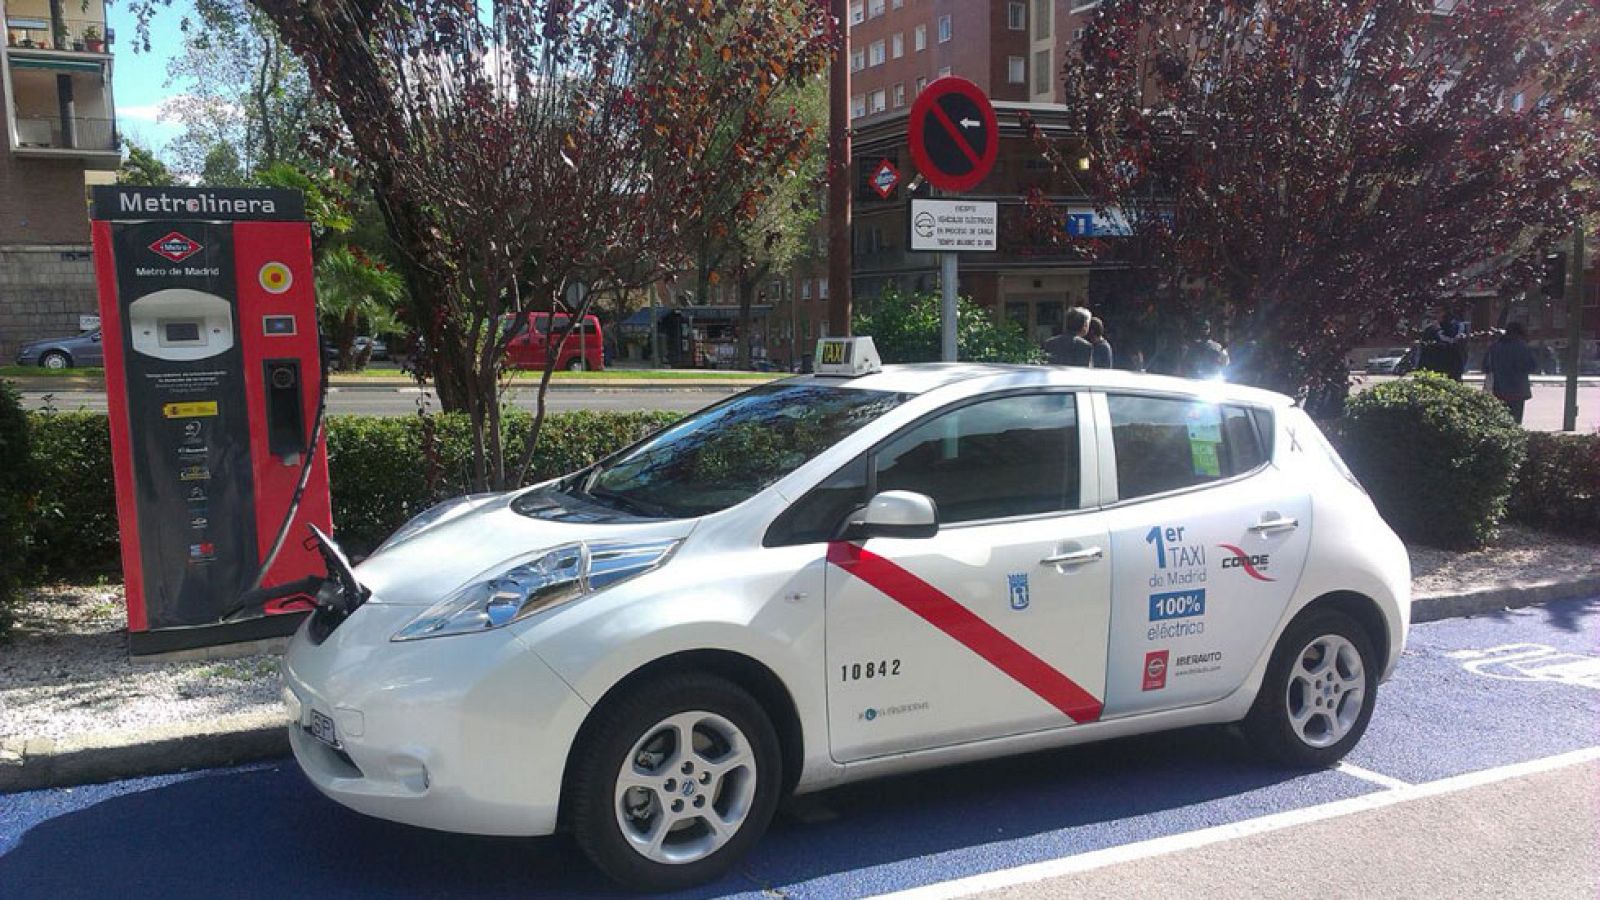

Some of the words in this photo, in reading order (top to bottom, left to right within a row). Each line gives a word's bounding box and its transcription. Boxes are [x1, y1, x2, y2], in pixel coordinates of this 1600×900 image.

[119, 193, 276, 213] Metrolinera
[136, 267, 166, 276] Metro
[169, 267, 182, 276] de
[184, 266, 220, 276] Madrid
[1146, 526, 1184, 568] 1er
[1169, 544, 1206, 568] TAXI
[1149, 572, 1163, 587] de
[1167, 568, 1206, 586] Madrid
[1156, 595, 1201, 616] 100%
[1147, 620, 1204, 640] eléctrico
[841, 659, 901, 682] 10842
